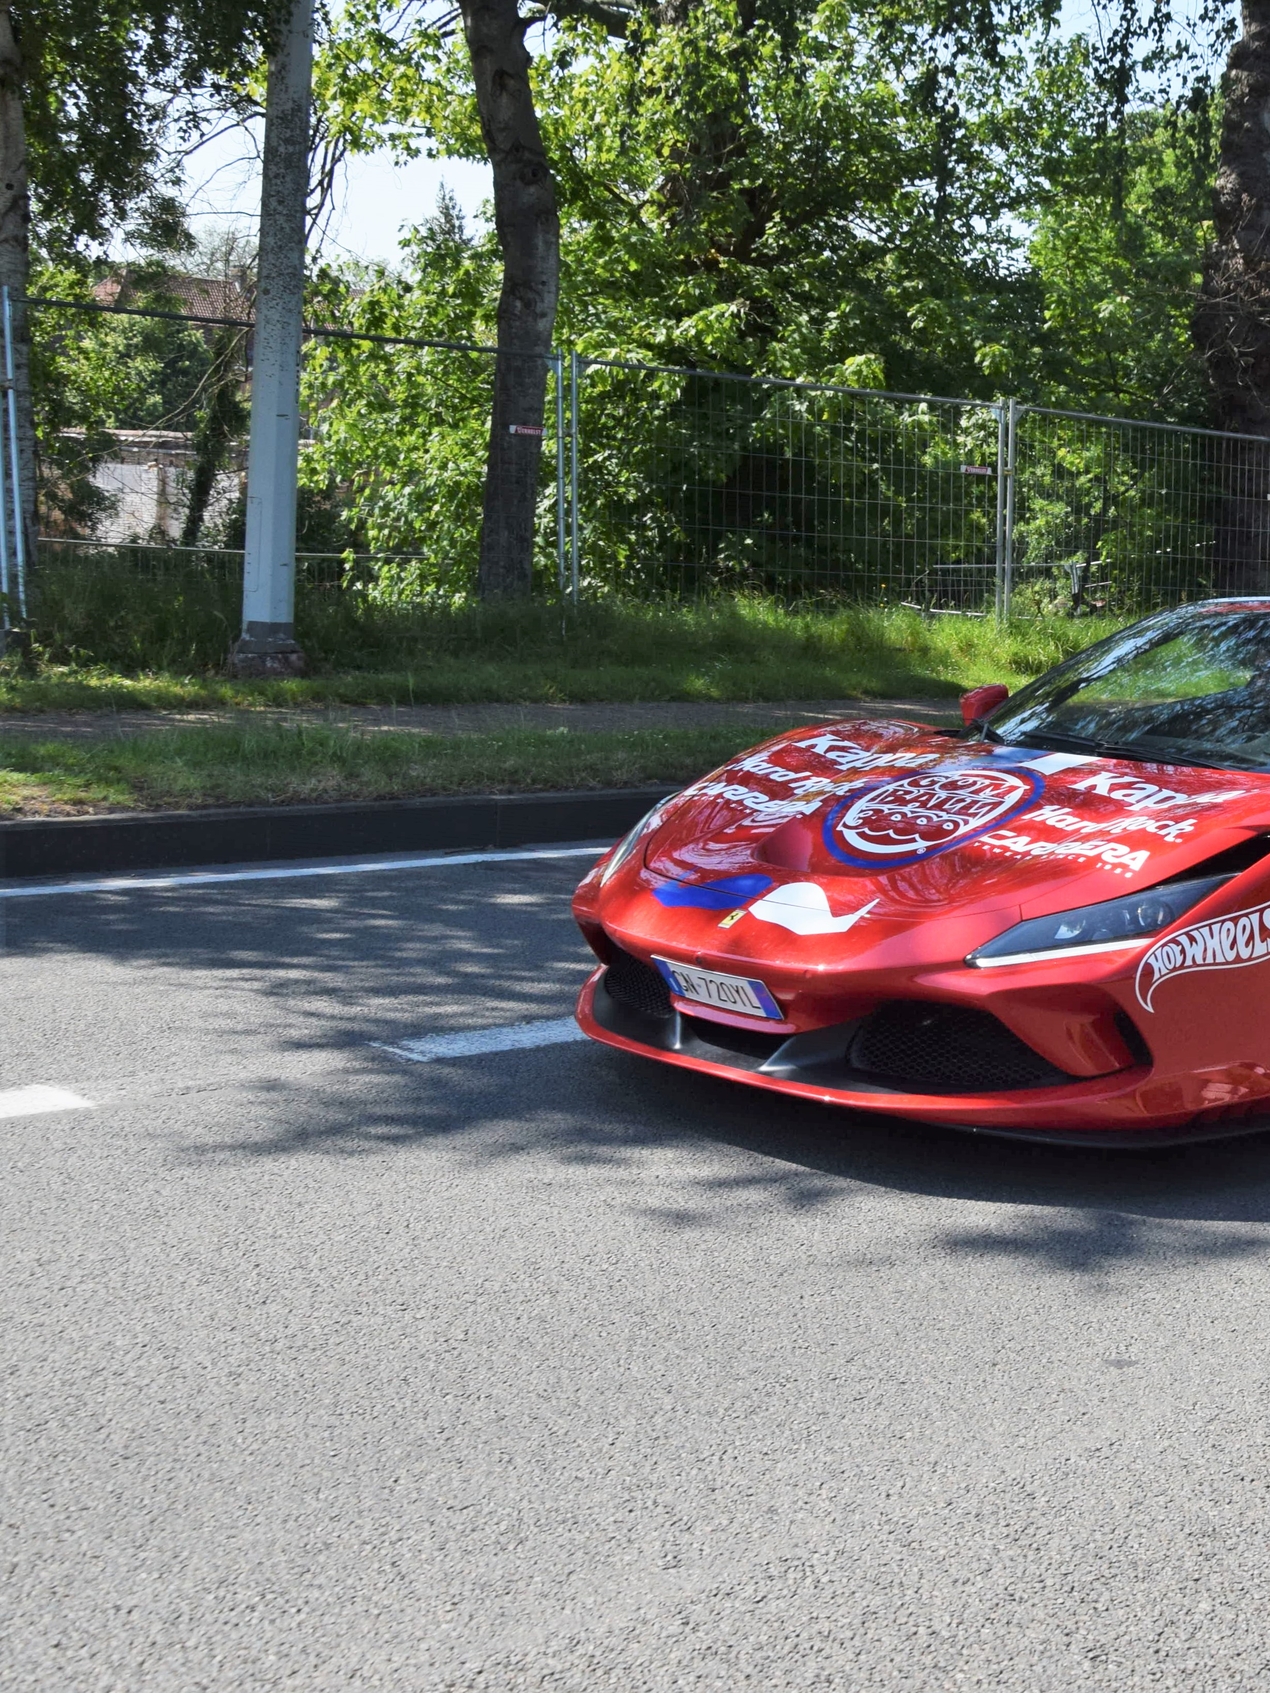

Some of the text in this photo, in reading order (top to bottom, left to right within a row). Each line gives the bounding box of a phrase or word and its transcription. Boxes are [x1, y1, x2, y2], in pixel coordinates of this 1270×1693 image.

[724, 756, 813, 782] Hard
[791, 734, 941, 771] Kappa
[978, 829, 1151, 871] CARRERA
